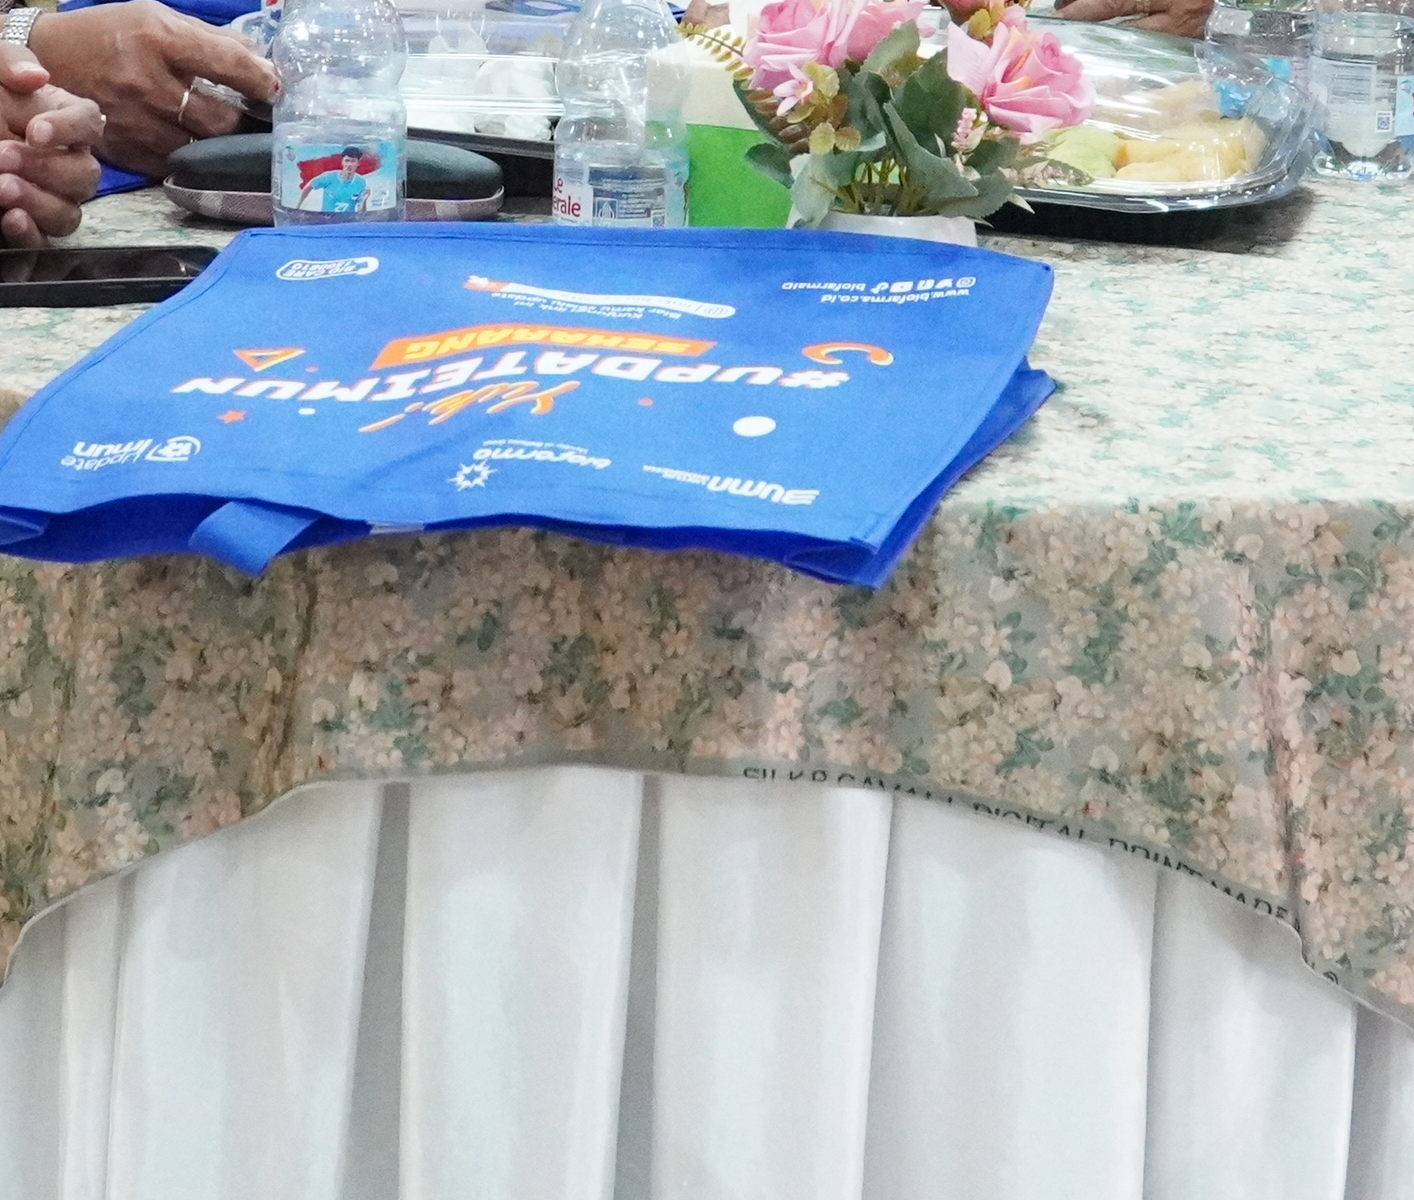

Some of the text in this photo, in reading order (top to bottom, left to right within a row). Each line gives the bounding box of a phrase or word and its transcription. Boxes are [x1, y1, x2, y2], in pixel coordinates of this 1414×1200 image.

[281, 269, 325, 277] CARE
[820, 288, 969, 304] www.biofarma.co.id
[170, 351, 850, 402] #UPDATEIMUN
